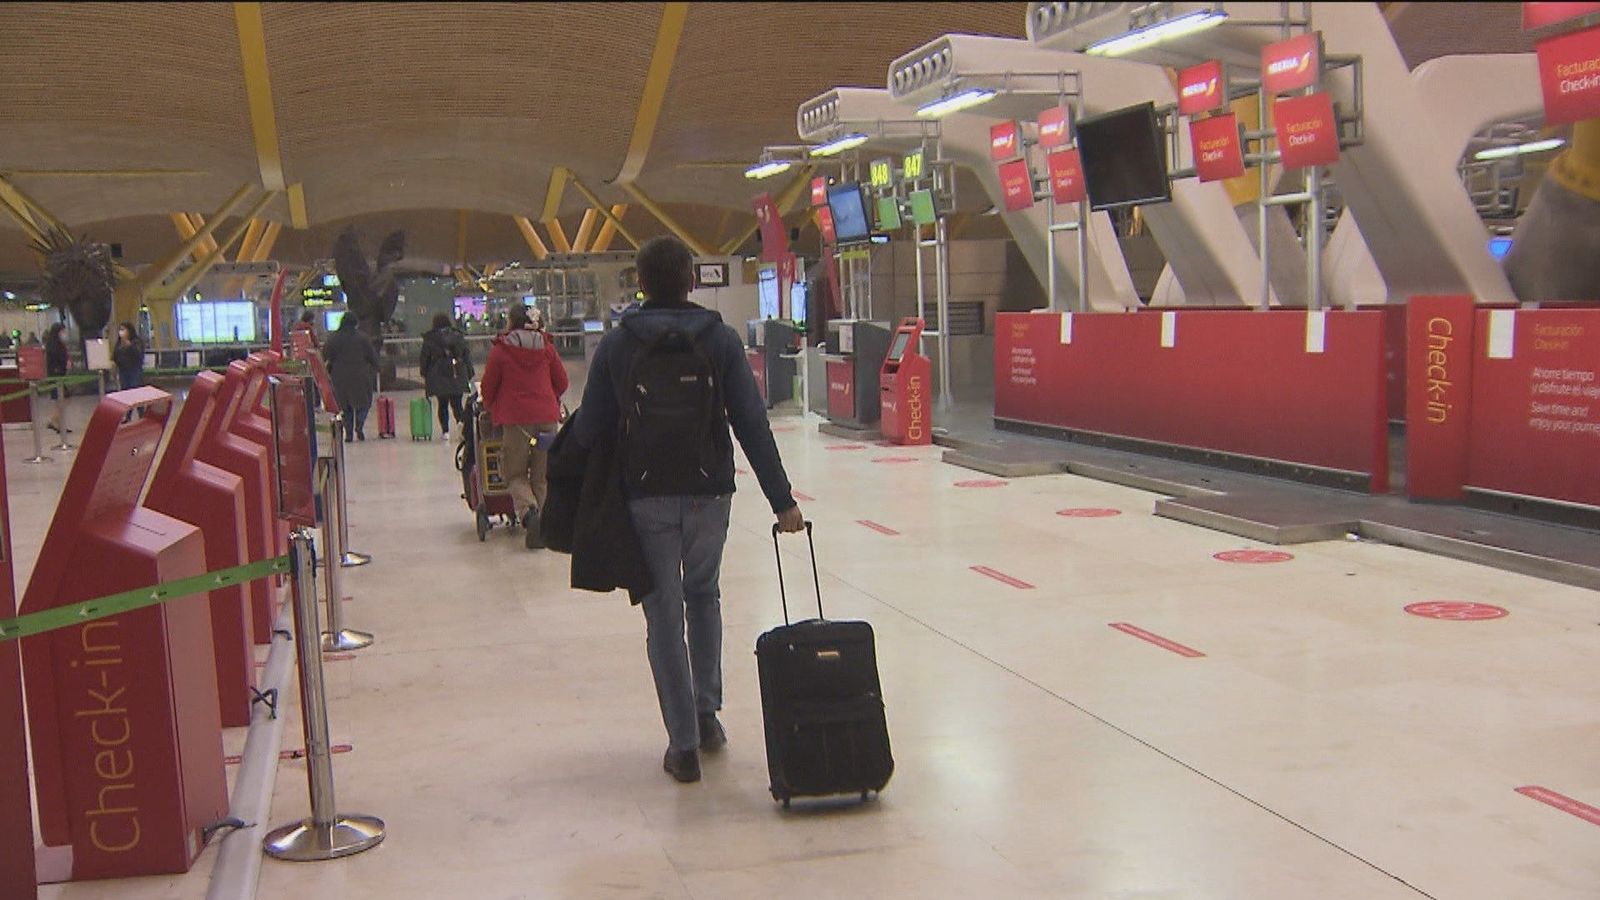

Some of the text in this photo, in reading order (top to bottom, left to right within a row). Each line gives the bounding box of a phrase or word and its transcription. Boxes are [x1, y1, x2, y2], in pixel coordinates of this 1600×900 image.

[871, 163, 888, 186] 848
[904, 153, 920, 178] 847
[1427, 317, 1453, 423] Check-in
[908, 376, 922, 440] Check-in
[73, 620, 140, 852] Check-in
